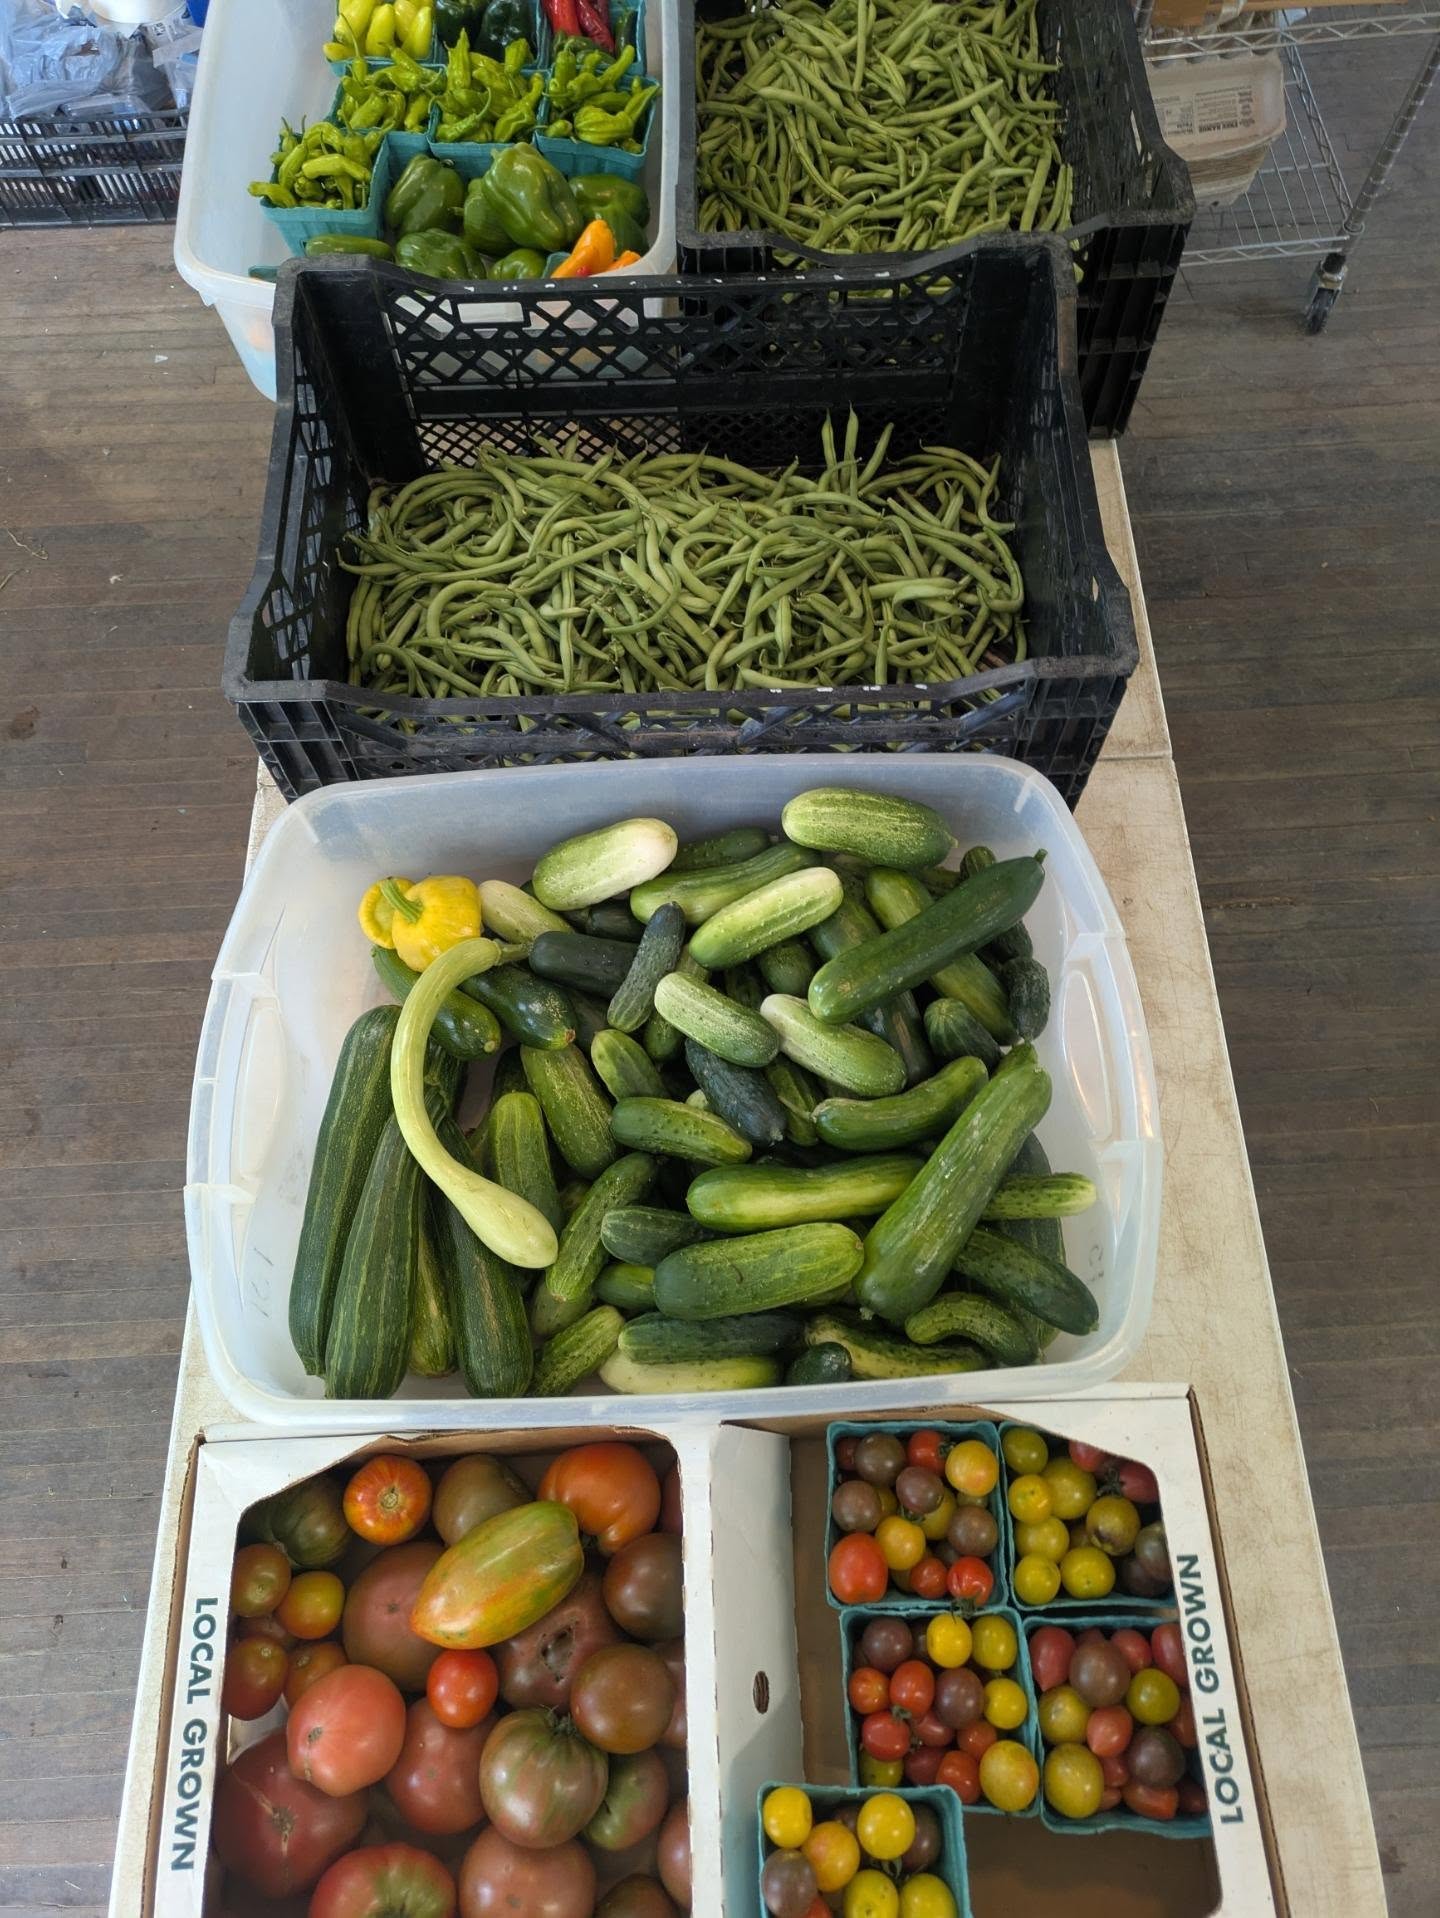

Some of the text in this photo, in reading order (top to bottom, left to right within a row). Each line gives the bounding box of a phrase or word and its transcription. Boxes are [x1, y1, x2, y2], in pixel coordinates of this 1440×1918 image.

[171, 1597, 218, 1871] LOCAL GROWN
[1177, 1555, 1243, 1824] LOCAL GROWN
